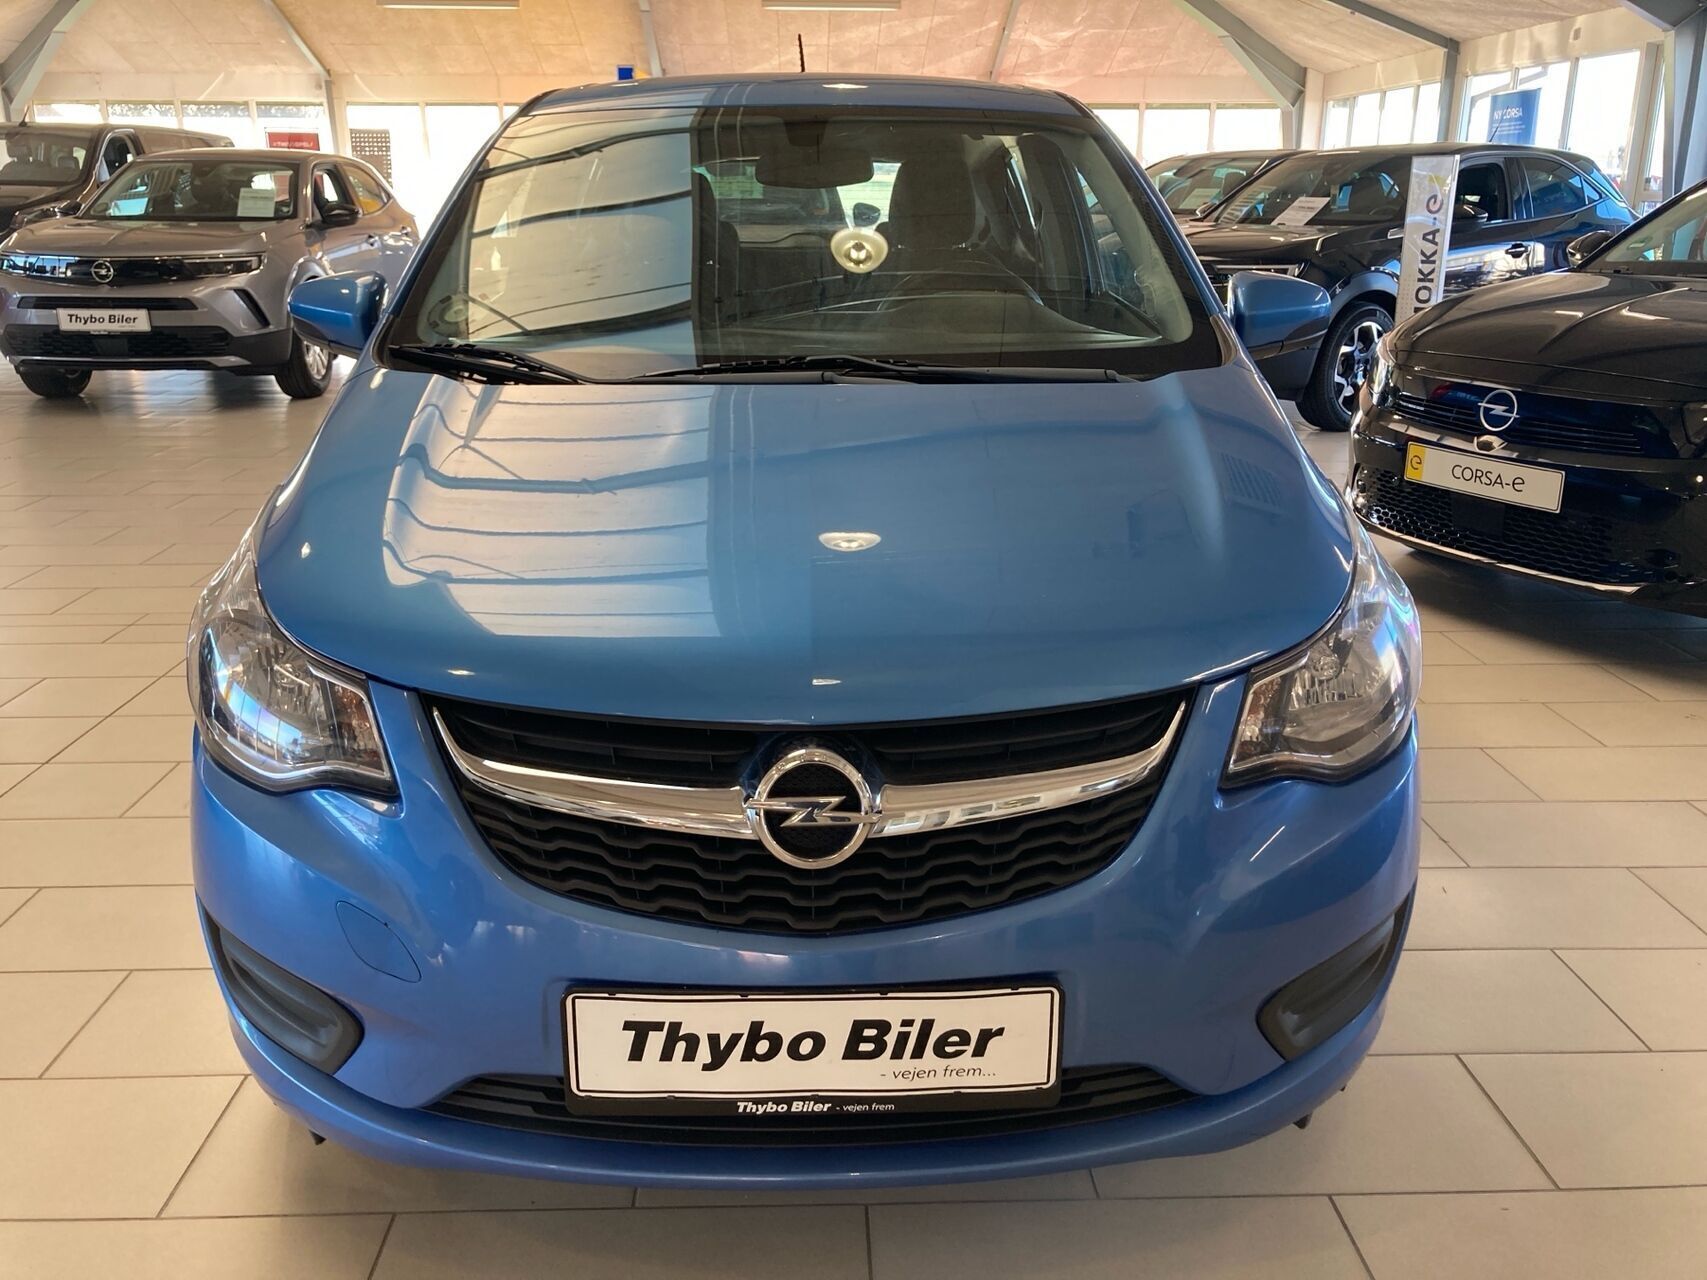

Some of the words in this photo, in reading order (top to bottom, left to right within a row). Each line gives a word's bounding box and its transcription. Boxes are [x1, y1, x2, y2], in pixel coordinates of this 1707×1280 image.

[1413, 194, 1444, 314] OKKA-e
[67, 313, 105, 325] Thybo
[108, 314, 138, 324] Biler
[1410, 455, 1422, 470] e
[1451, 464, 1525, 493] CORSA-e
[621, 1020, 826, 1071] Thybo
[841, 1018, 1005, 1061] Biler
[892, 1067, 937, 1082] vejen
[943, 1065, 996, 1078] frem...
[737, 1101, 788, 1115] Thybo
[790, 1101, 832, 1112] Biler
[842, 1103, 869, 1112] vejen
[871, 1103, 895, 1111] frem
